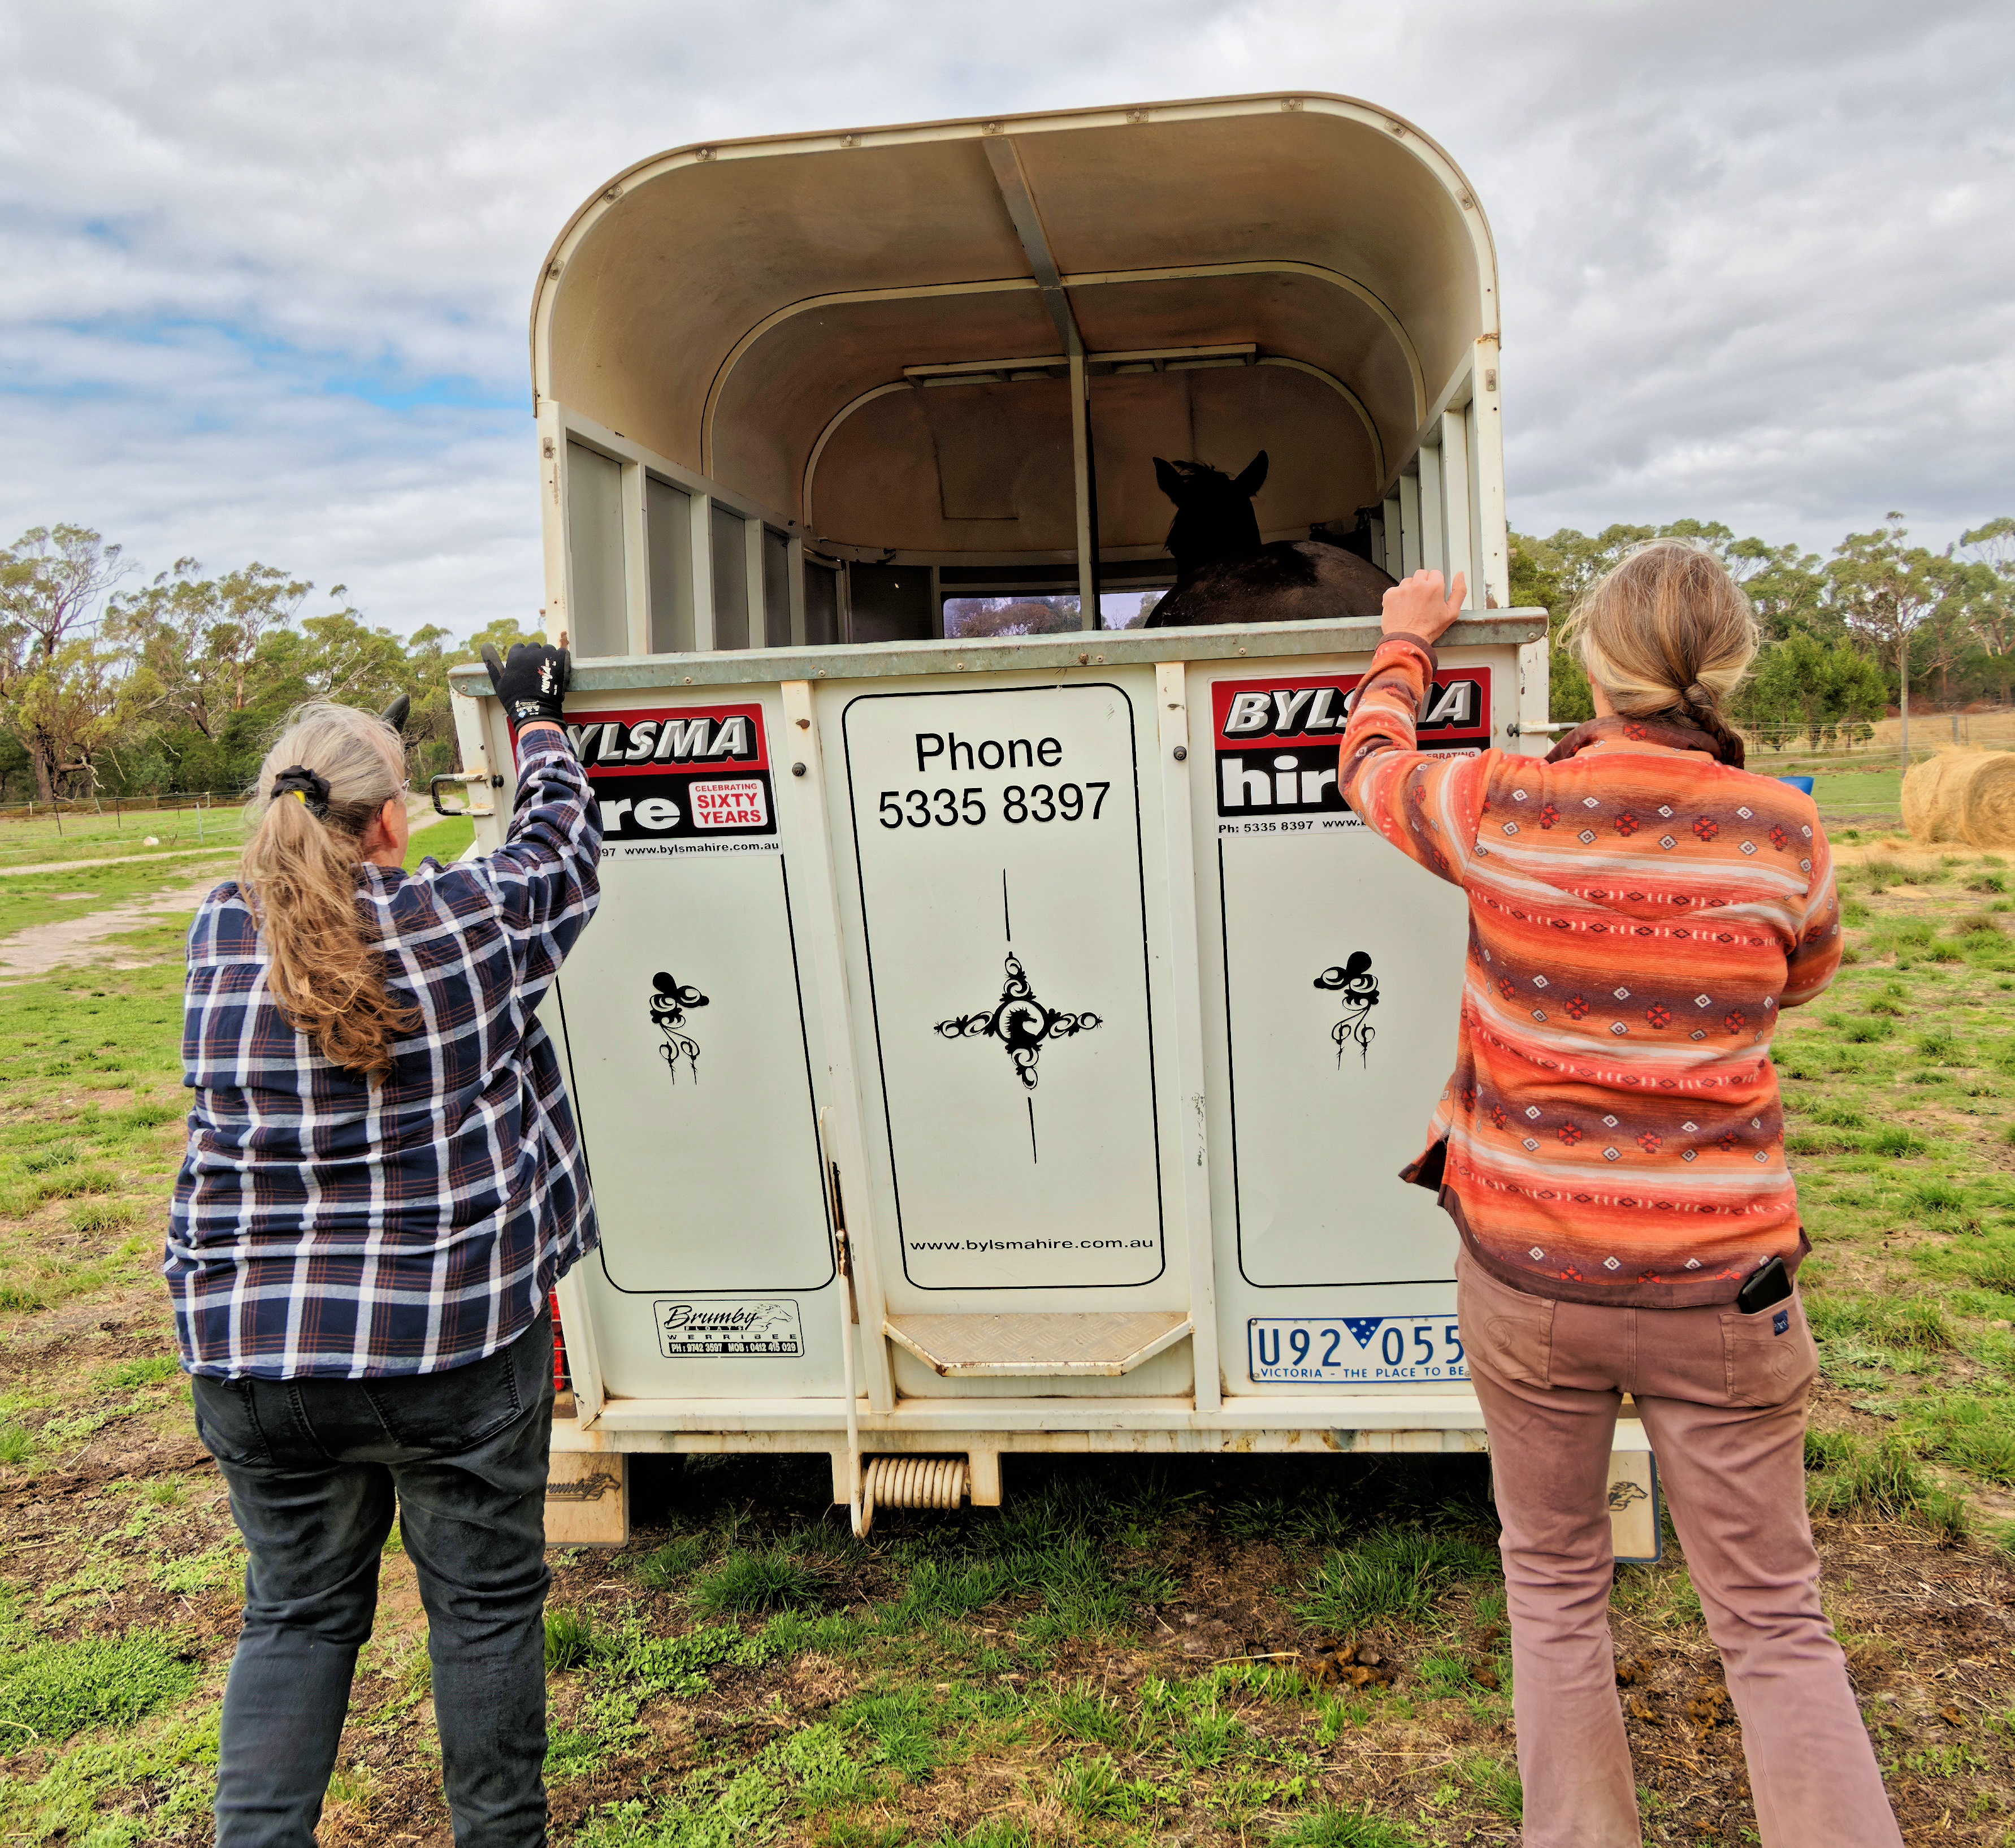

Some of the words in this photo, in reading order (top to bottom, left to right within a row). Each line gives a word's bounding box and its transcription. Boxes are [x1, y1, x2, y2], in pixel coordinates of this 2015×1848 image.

[566, 716, 748, 760] YLSMA
[916, 733, 1062, 772] Phone
[1221, 755, 1336, 807] hir
[697, 793, 757, 808] SIXTY
[879, 788, 986, 828] 5335
[1003, 782, 1110, 823] 8397
[599, 797, 681, 832] re
[699, 810, 761, 824] YEARS
[1219, 825, 1239, 833] Ph:
[1244, 822, 1276, 832] 5335
[1281, 820, 1314, 830] 8397
[601, 848, 616, 856] 97
[624, 843, 779, 855] www.bylsmahire.com.au
[910, 1239, 1153, 1252] www.bylsmahire.com.au
[664, 1305, 759, 1330] Brumby
[1258, 1328, 1342, 1367] U92
[1382, 1326, 1464, 1366] 055
[1260, 1368, 1322, 1378] VICTORIA
[1344, 1369, 1367, 1378] THE
[1376, 1367, 1415, 1378] PLACE
[1424, 1367, 1441, 1376] TO
[1449, 1366, 1464, 1376] BE
